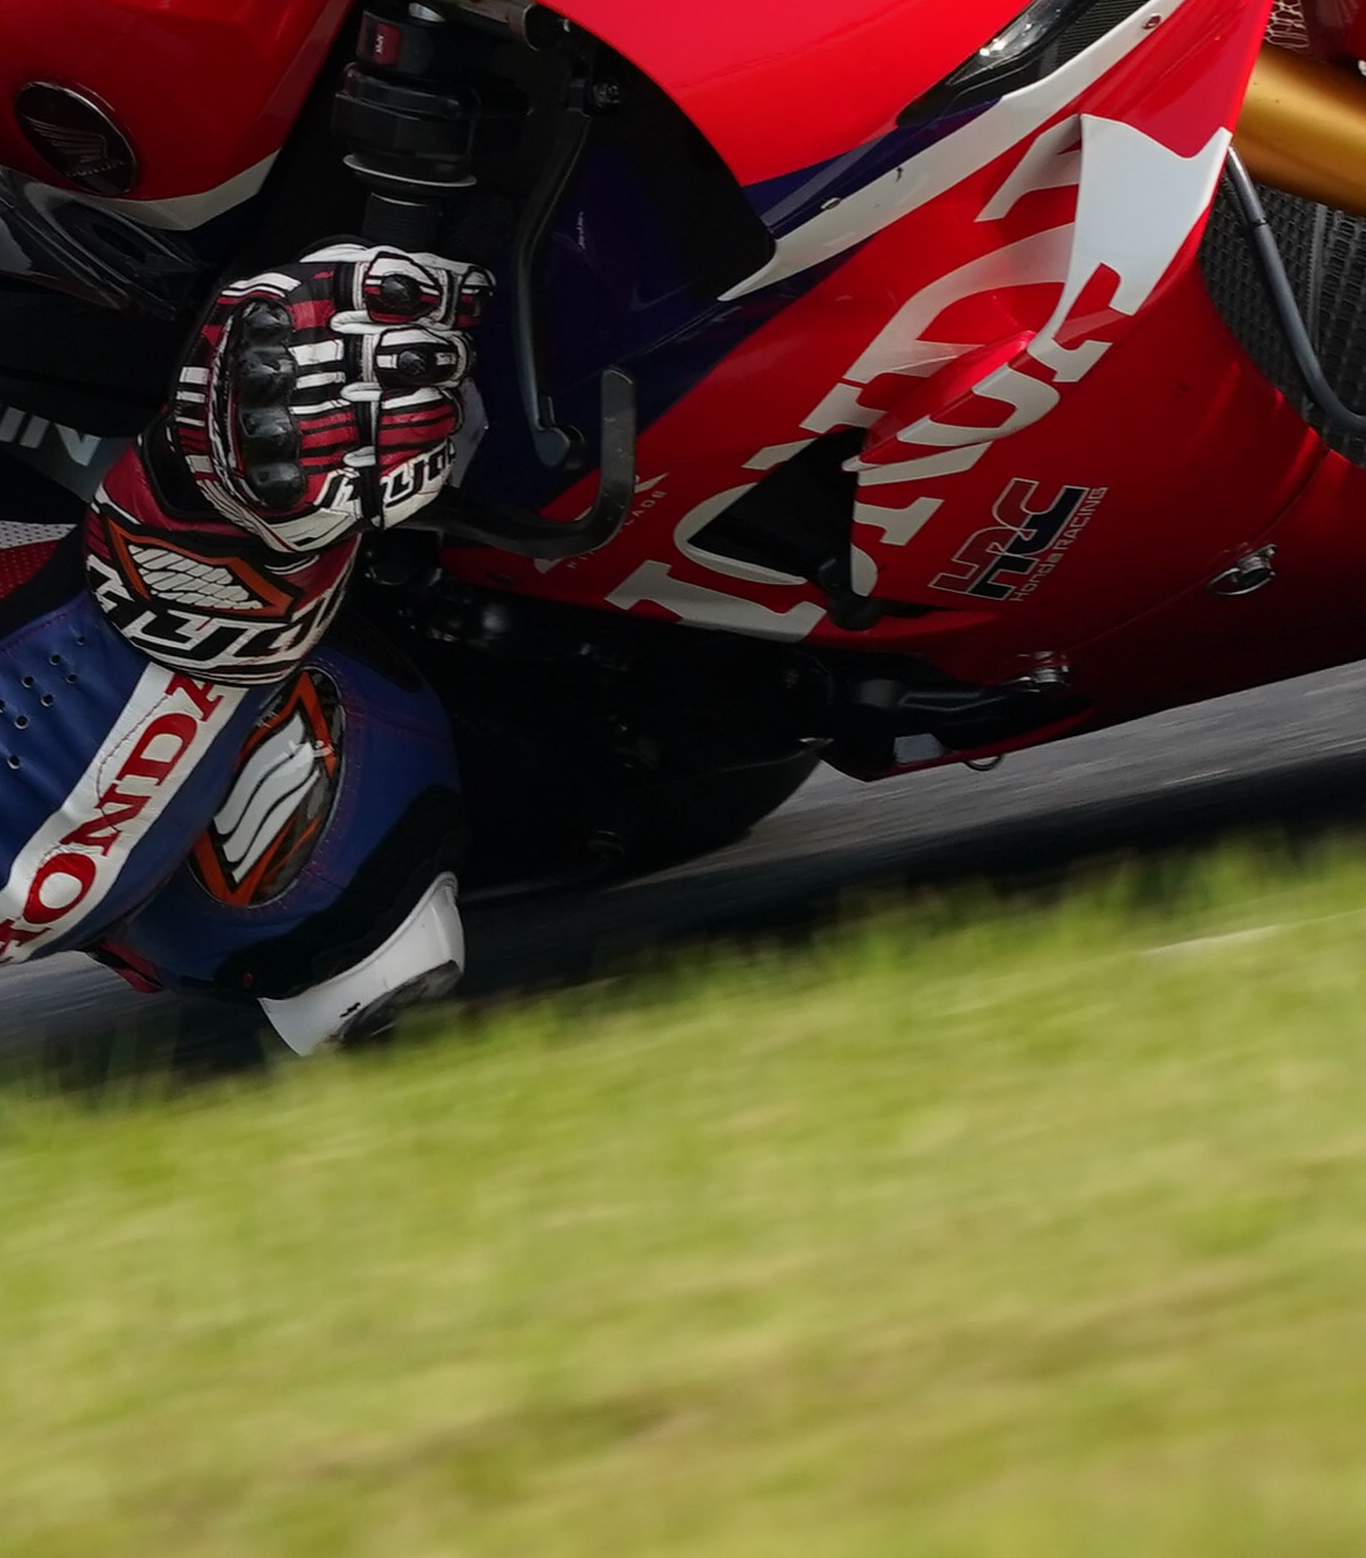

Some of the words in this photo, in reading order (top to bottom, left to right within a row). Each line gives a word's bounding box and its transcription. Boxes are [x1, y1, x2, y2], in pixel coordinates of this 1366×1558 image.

[927, 476, 1092, 601] HRC
[1008, 553, 1065, 602] Honda
[1052, 486, 1110, 550] RACING
